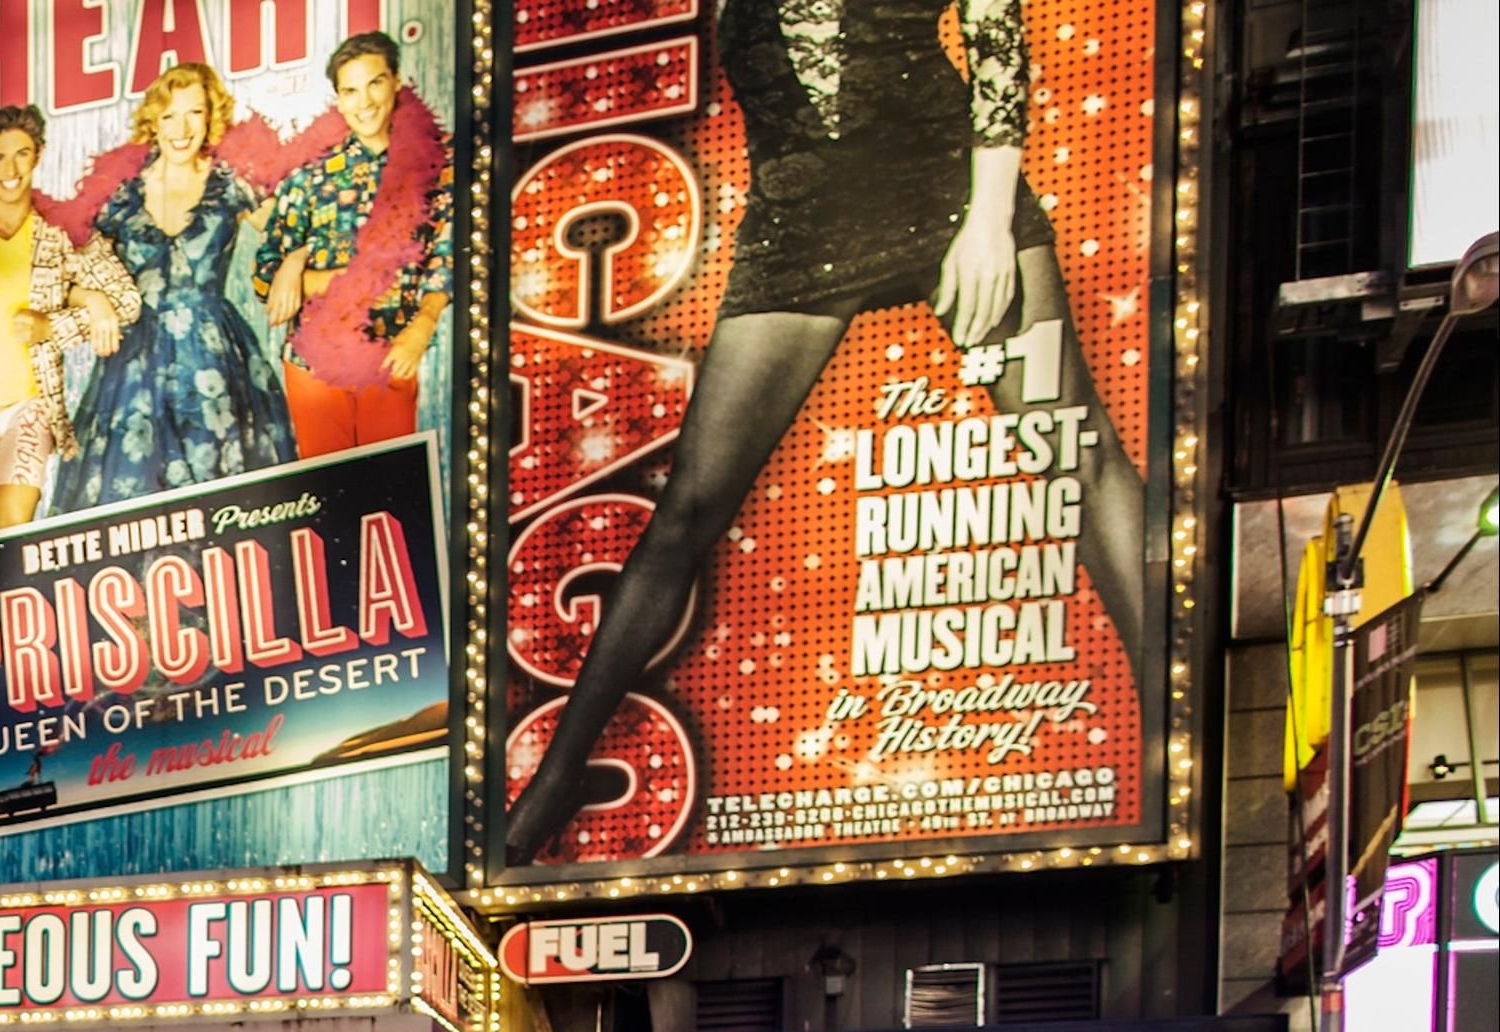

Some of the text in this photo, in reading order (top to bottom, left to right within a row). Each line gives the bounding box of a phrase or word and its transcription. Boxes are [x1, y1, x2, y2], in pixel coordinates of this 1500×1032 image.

[877, 376, 949, 420] The
[959, 319, 1063, 403] #1
[855, 406, 1099, 491] LONGEST-
[22, 492, 322, 575] BETTE MIDLER Presents
[855, 476, 1082, 557] RUNNING
[854, 542, 1076, 613] AMERICAN
[851, 600, 1077, 677] MUSICAL
[103, 702, 152, 735] OF
[168, 682, 247, 722] THE
[264, 647, 427, 708] DESERT
[826, 674, 1098, 722] in Broadway
[88, 713, 285, 787] the musical
[871, 709, 1045, 763] History!
[833, 818, 900, 837] THEATRE
[1024, 802, 1115, 823] BROADWAY
[186, 892, 355, 999] FUN!
[529, 922, 659, 974] FUEL
